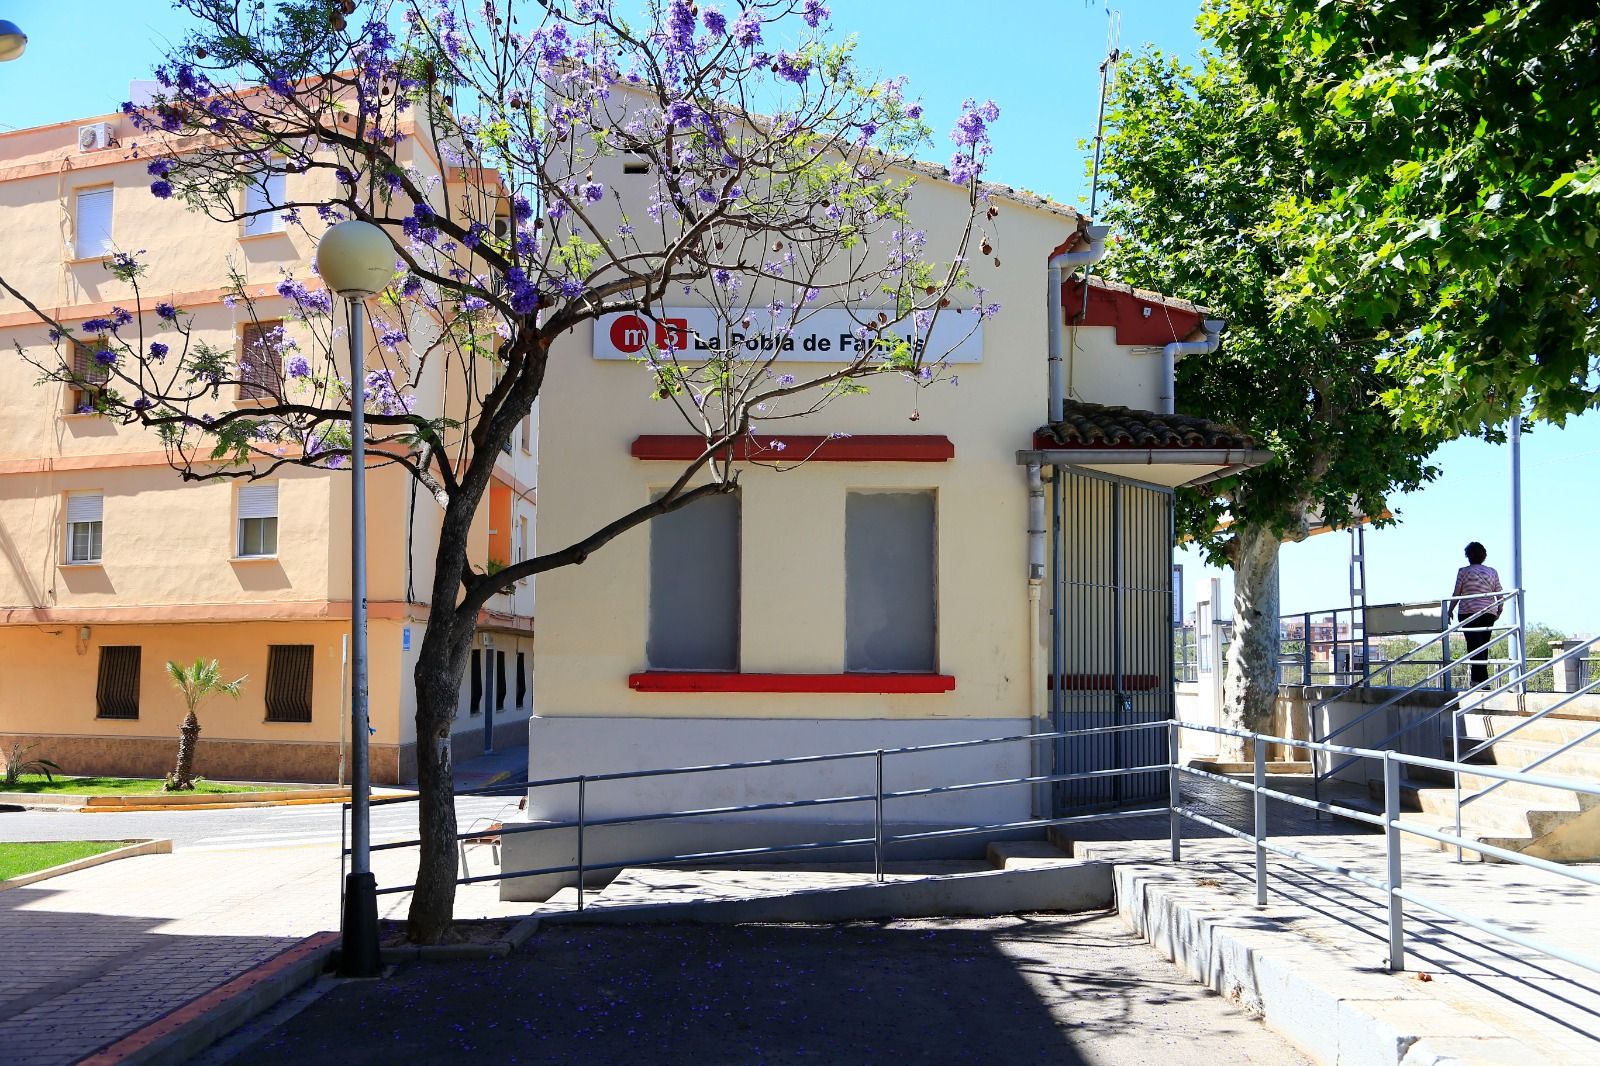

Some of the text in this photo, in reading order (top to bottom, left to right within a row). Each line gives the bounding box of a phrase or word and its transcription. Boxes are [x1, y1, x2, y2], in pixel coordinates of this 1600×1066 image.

[624, 329, 648, 346] m
[663, 323, 679, 347] 3
[694, 332, 721, 350] La
[731, 332, 795, 351] Pobla
[803, 333, 831, 352] de
